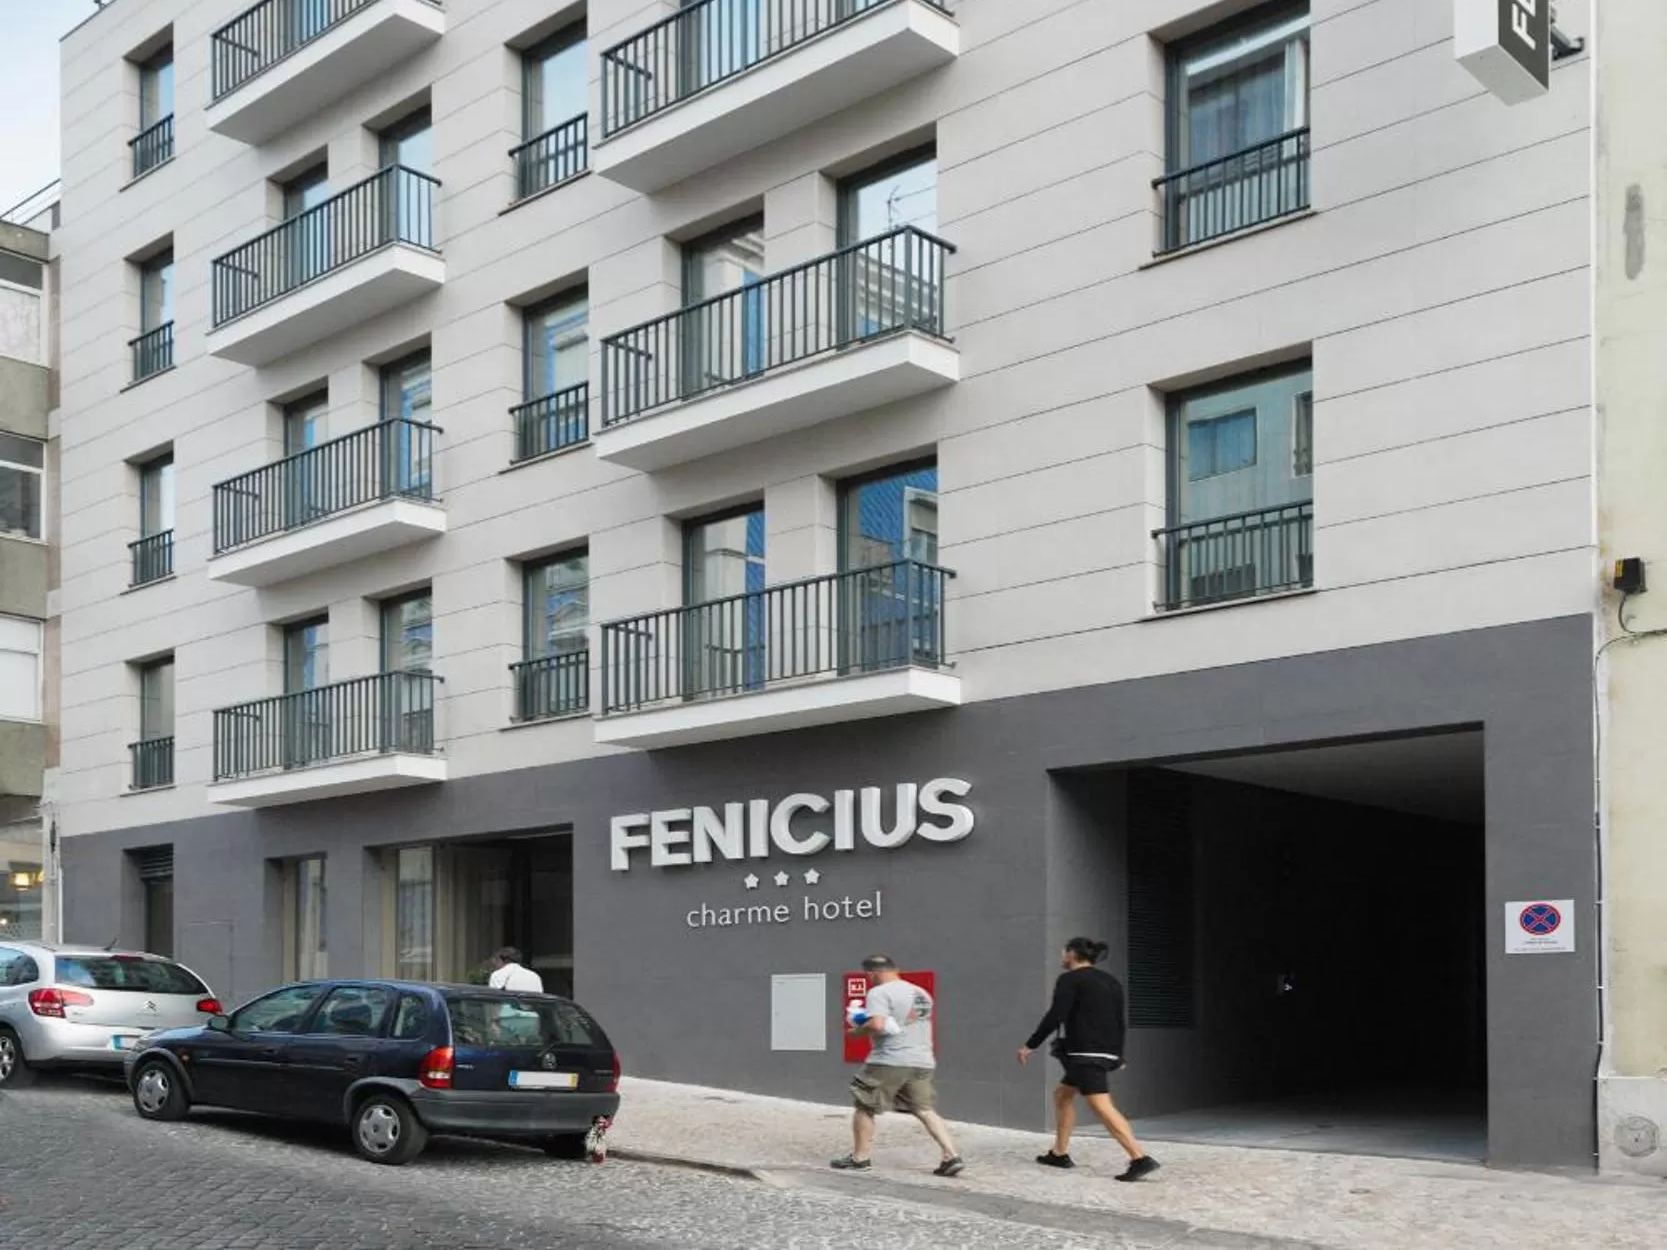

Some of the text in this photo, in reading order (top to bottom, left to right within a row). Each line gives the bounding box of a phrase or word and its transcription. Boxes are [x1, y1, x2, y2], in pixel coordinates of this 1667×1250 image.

[610, 777, 974, 871] FENICIUS
[686, 890, 882, 929] charme hotel
